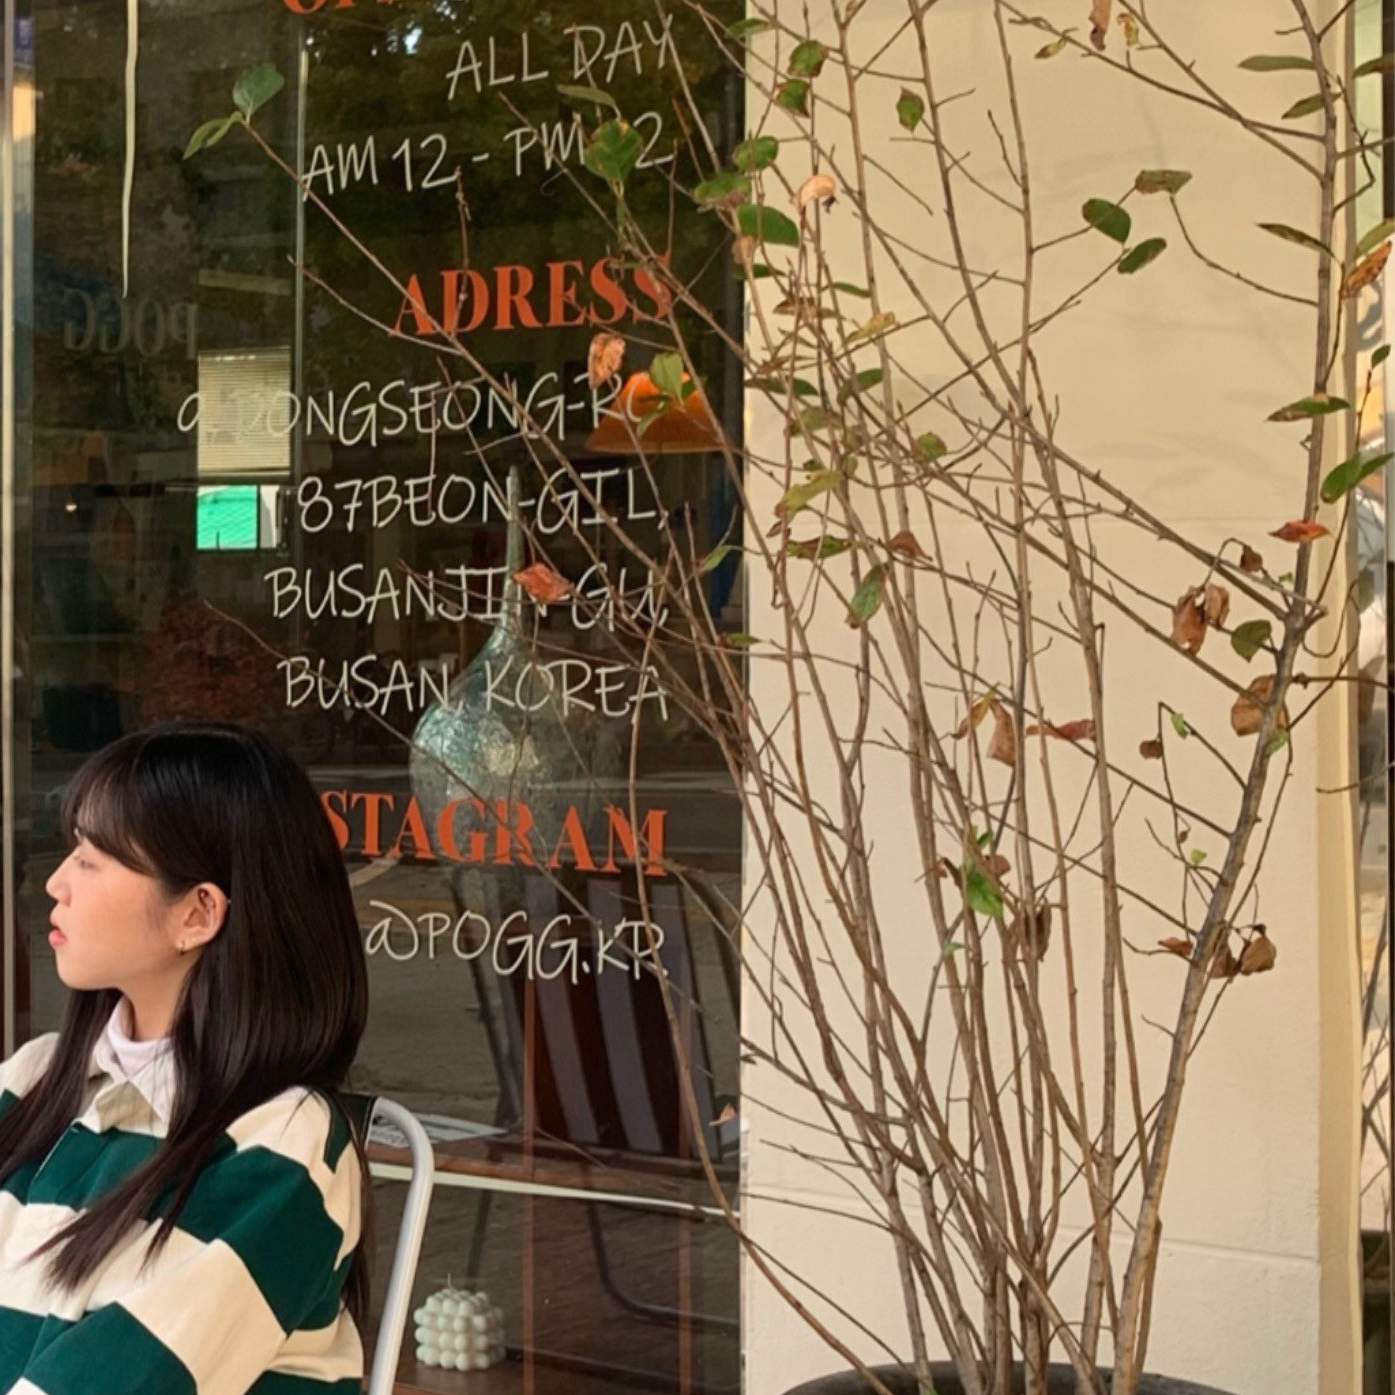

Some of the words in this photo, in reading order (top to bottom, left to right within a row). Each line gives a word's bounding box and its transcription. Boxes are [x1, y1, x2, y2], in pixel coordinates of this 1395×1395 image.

[446, 32, 549, 100] ALL
[564, 13, 673, 83] DAY
[301, 135, 378, 196] AM
[392, 133, 458, 192] 12
[504, 113, 586, 177] PM
[388, 257, 674, 338] ADRESS
[276, 654, 464, 716] BUSAN,
[484, 657, 669, 721] KOREA
[319, 789, 669, 877] STAGRAM
[365, 900, 669, 985] @POGG.KR
